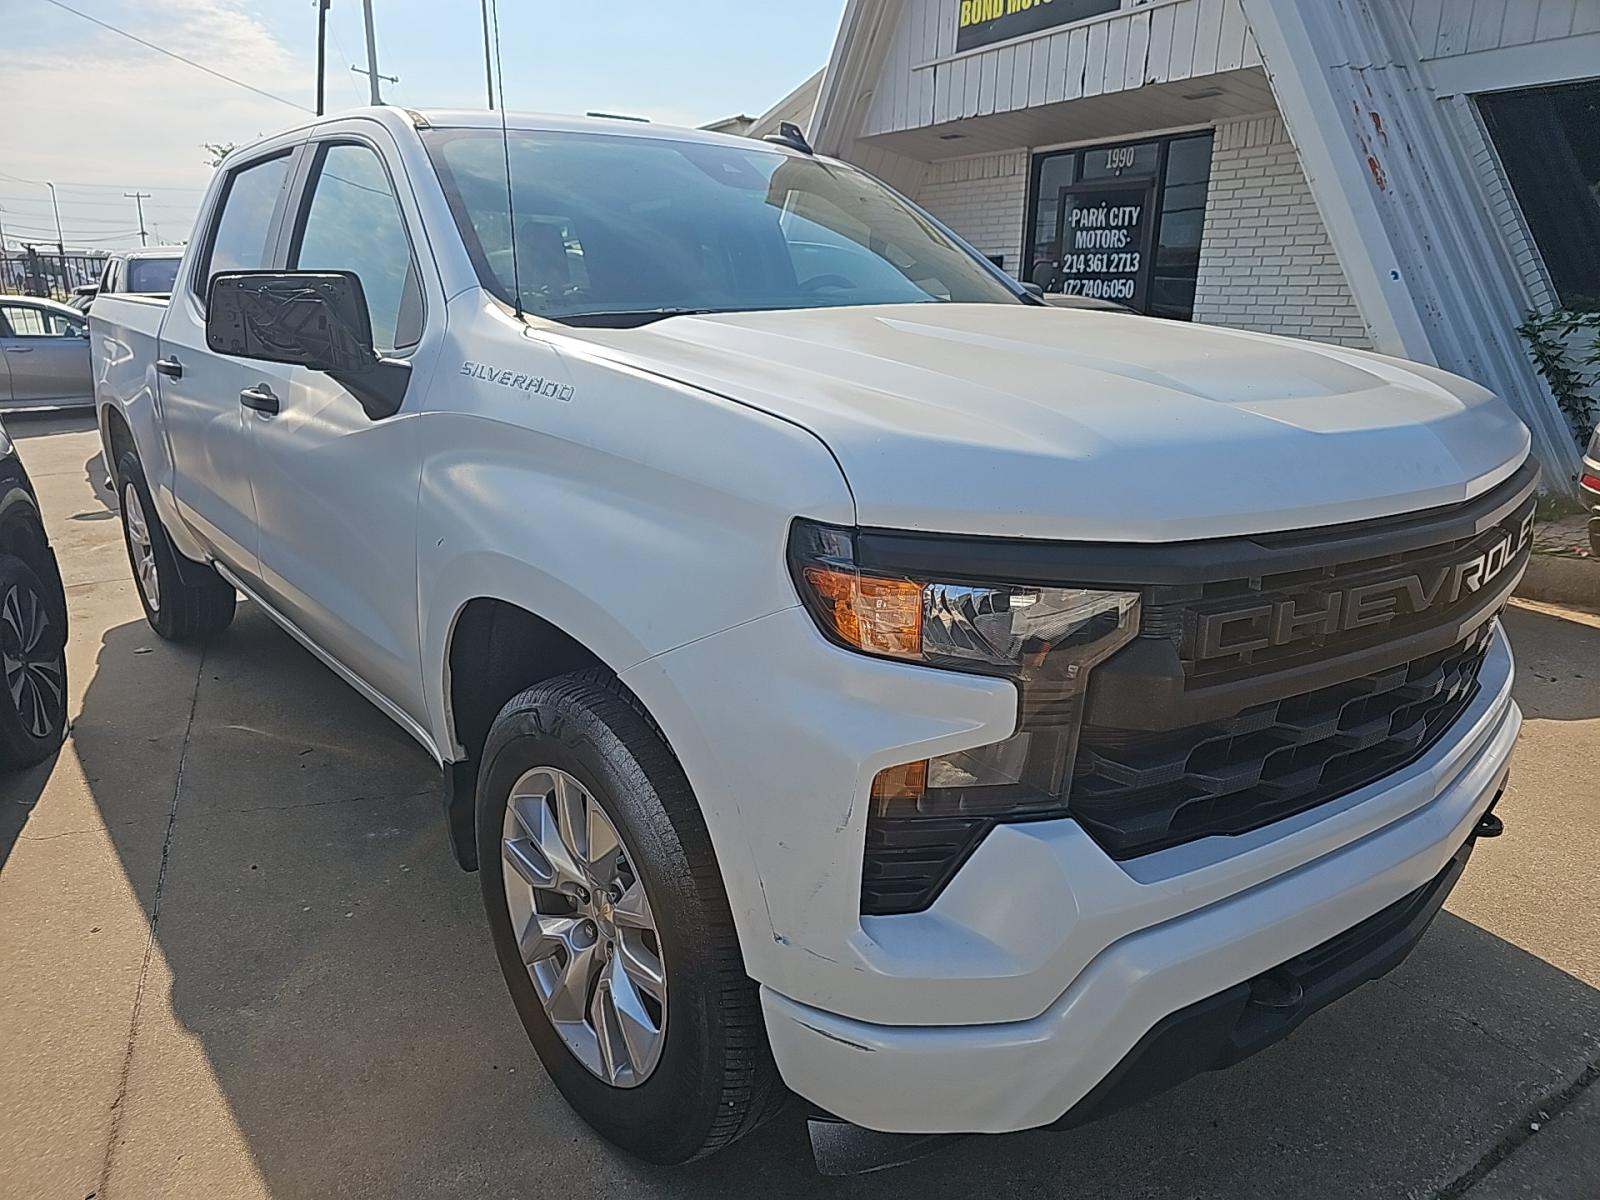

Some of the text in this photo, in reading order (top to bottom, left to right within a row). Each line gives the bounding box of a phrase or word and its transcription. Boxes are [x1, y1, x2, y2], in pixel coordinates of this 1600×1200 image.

[1106, 147, 1134, 168] 1990
[1071, 206, 1140, 227] PARK CITY
[1075, 229, 1127, 248] MOTORS
[460, 361, 575, 402] SILVERADO
